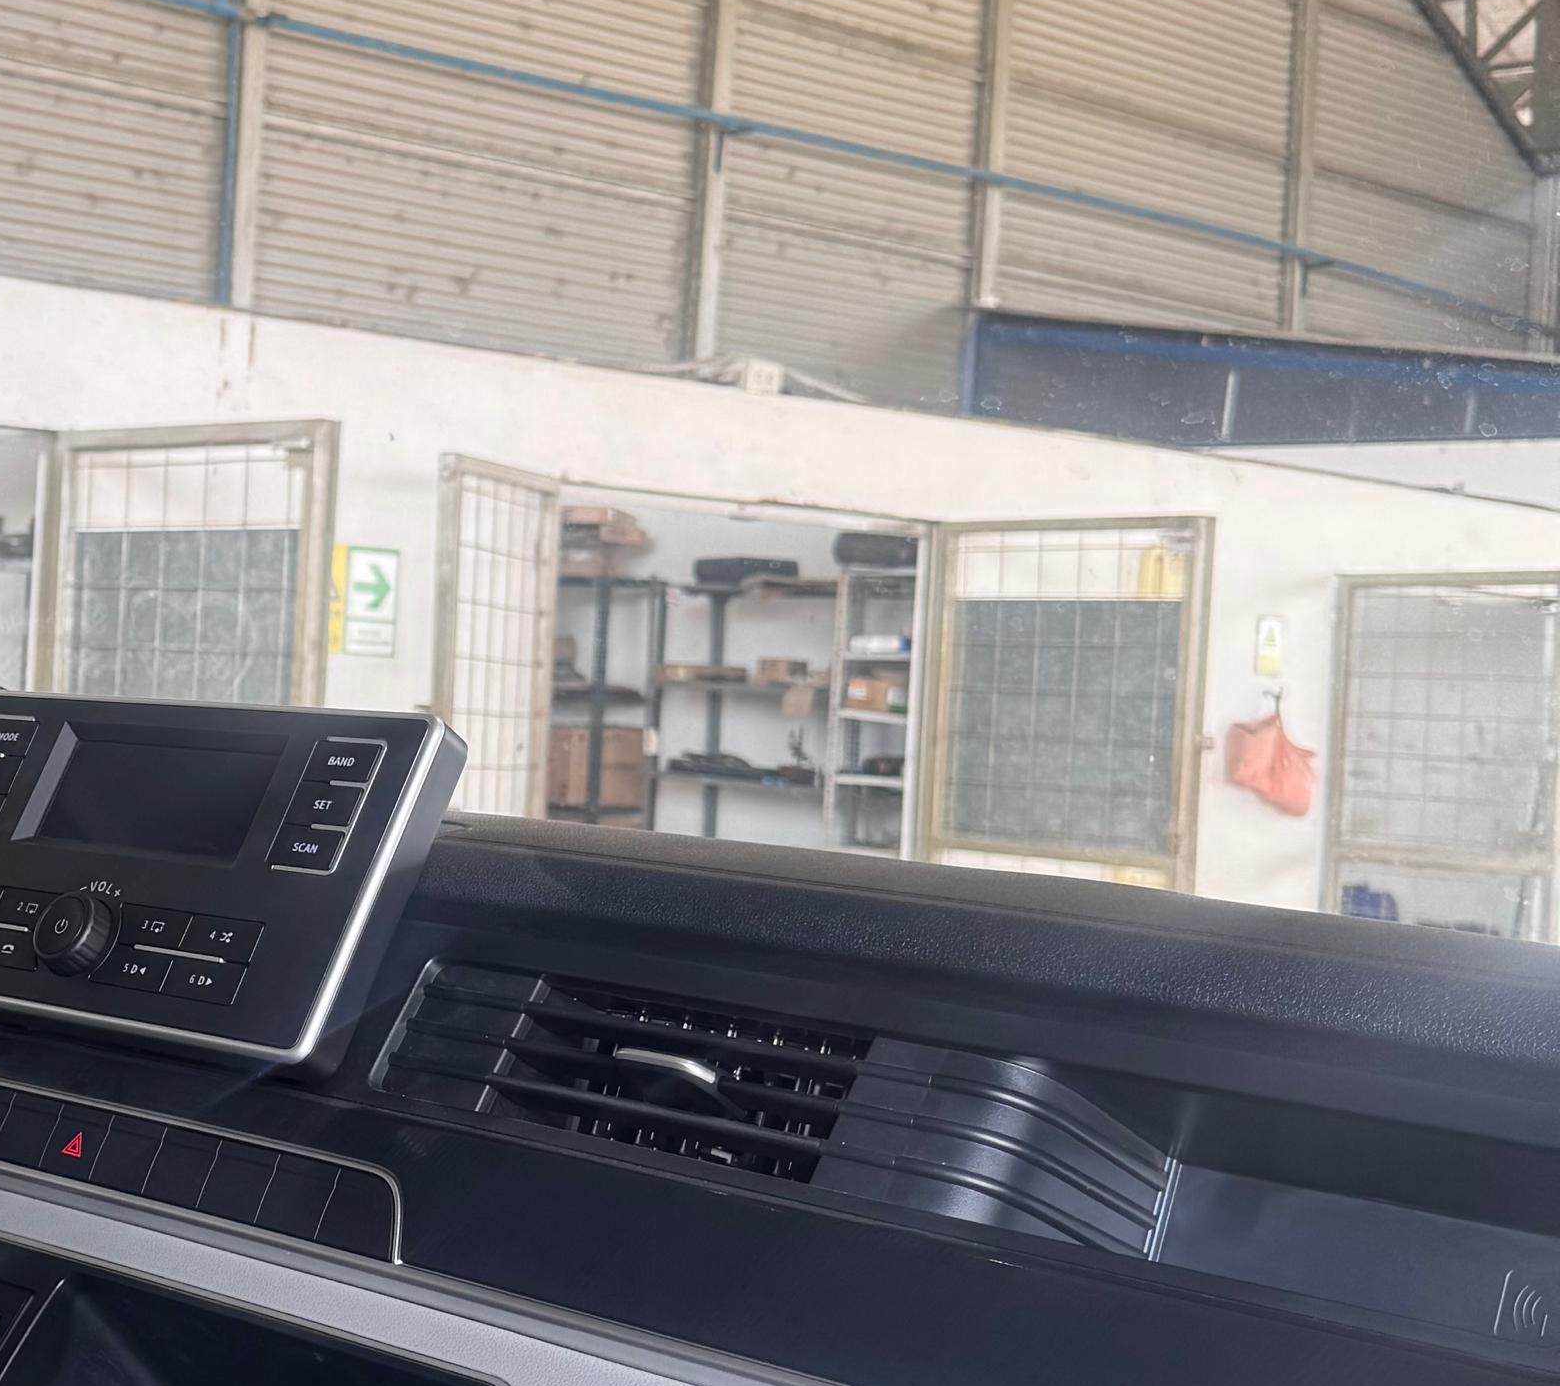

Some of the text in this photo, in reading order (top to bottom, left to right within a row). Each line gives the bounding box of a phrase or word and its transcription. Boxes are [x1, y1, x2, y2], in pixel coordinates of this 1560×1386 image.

[327, 756, 355, 767] BAND
[313, 800, 333, 810] SET
[292, 842, 319, 854] SCAN
[141, 920, 149, 930] 3
[209, 931, 217, 940] 4
